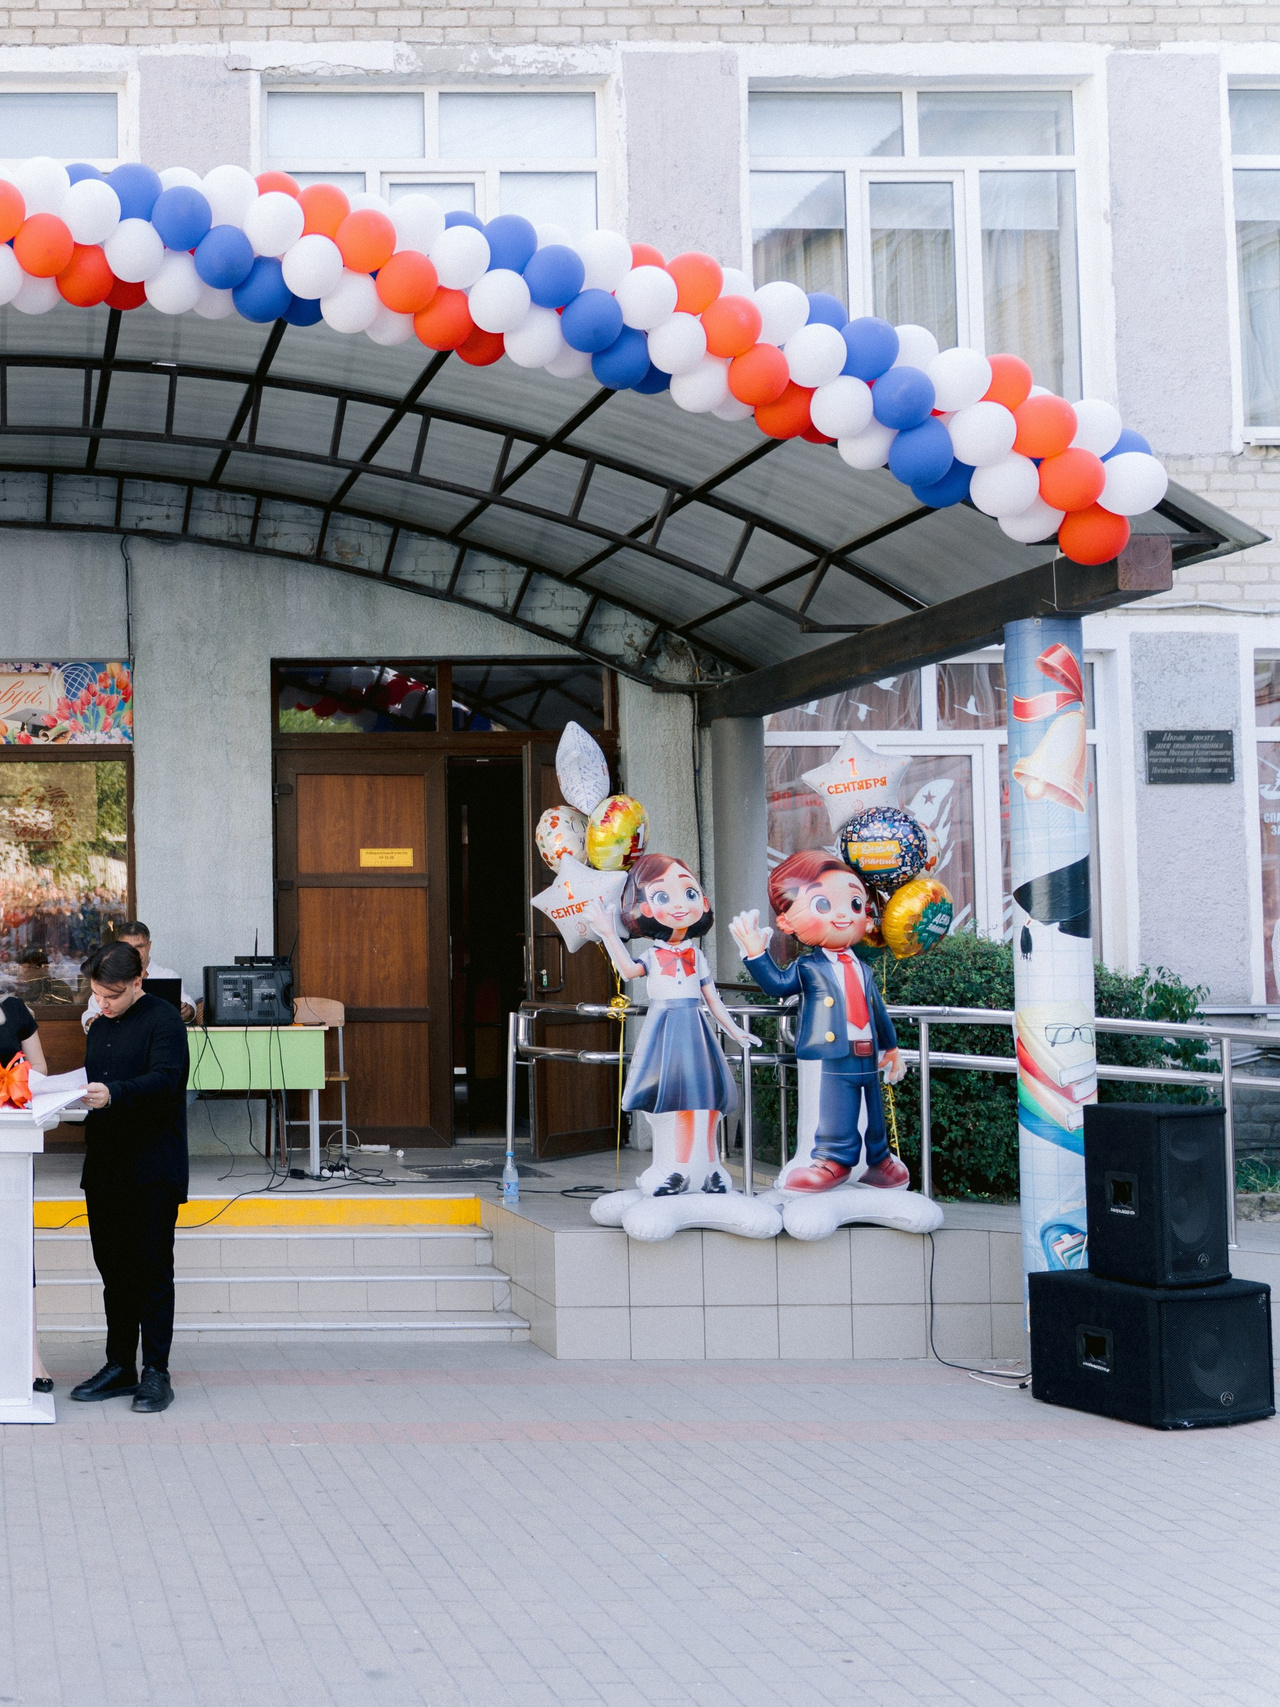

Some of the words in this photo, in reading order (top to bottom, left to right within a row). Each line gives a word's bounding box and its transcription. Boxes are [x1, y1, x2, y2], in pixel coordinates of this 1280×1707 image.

[848, 757, 859, 777] 1
[827, 775, 888, 795] СЕНТЯБРЯ
[563, 880, 575, 900] 1
